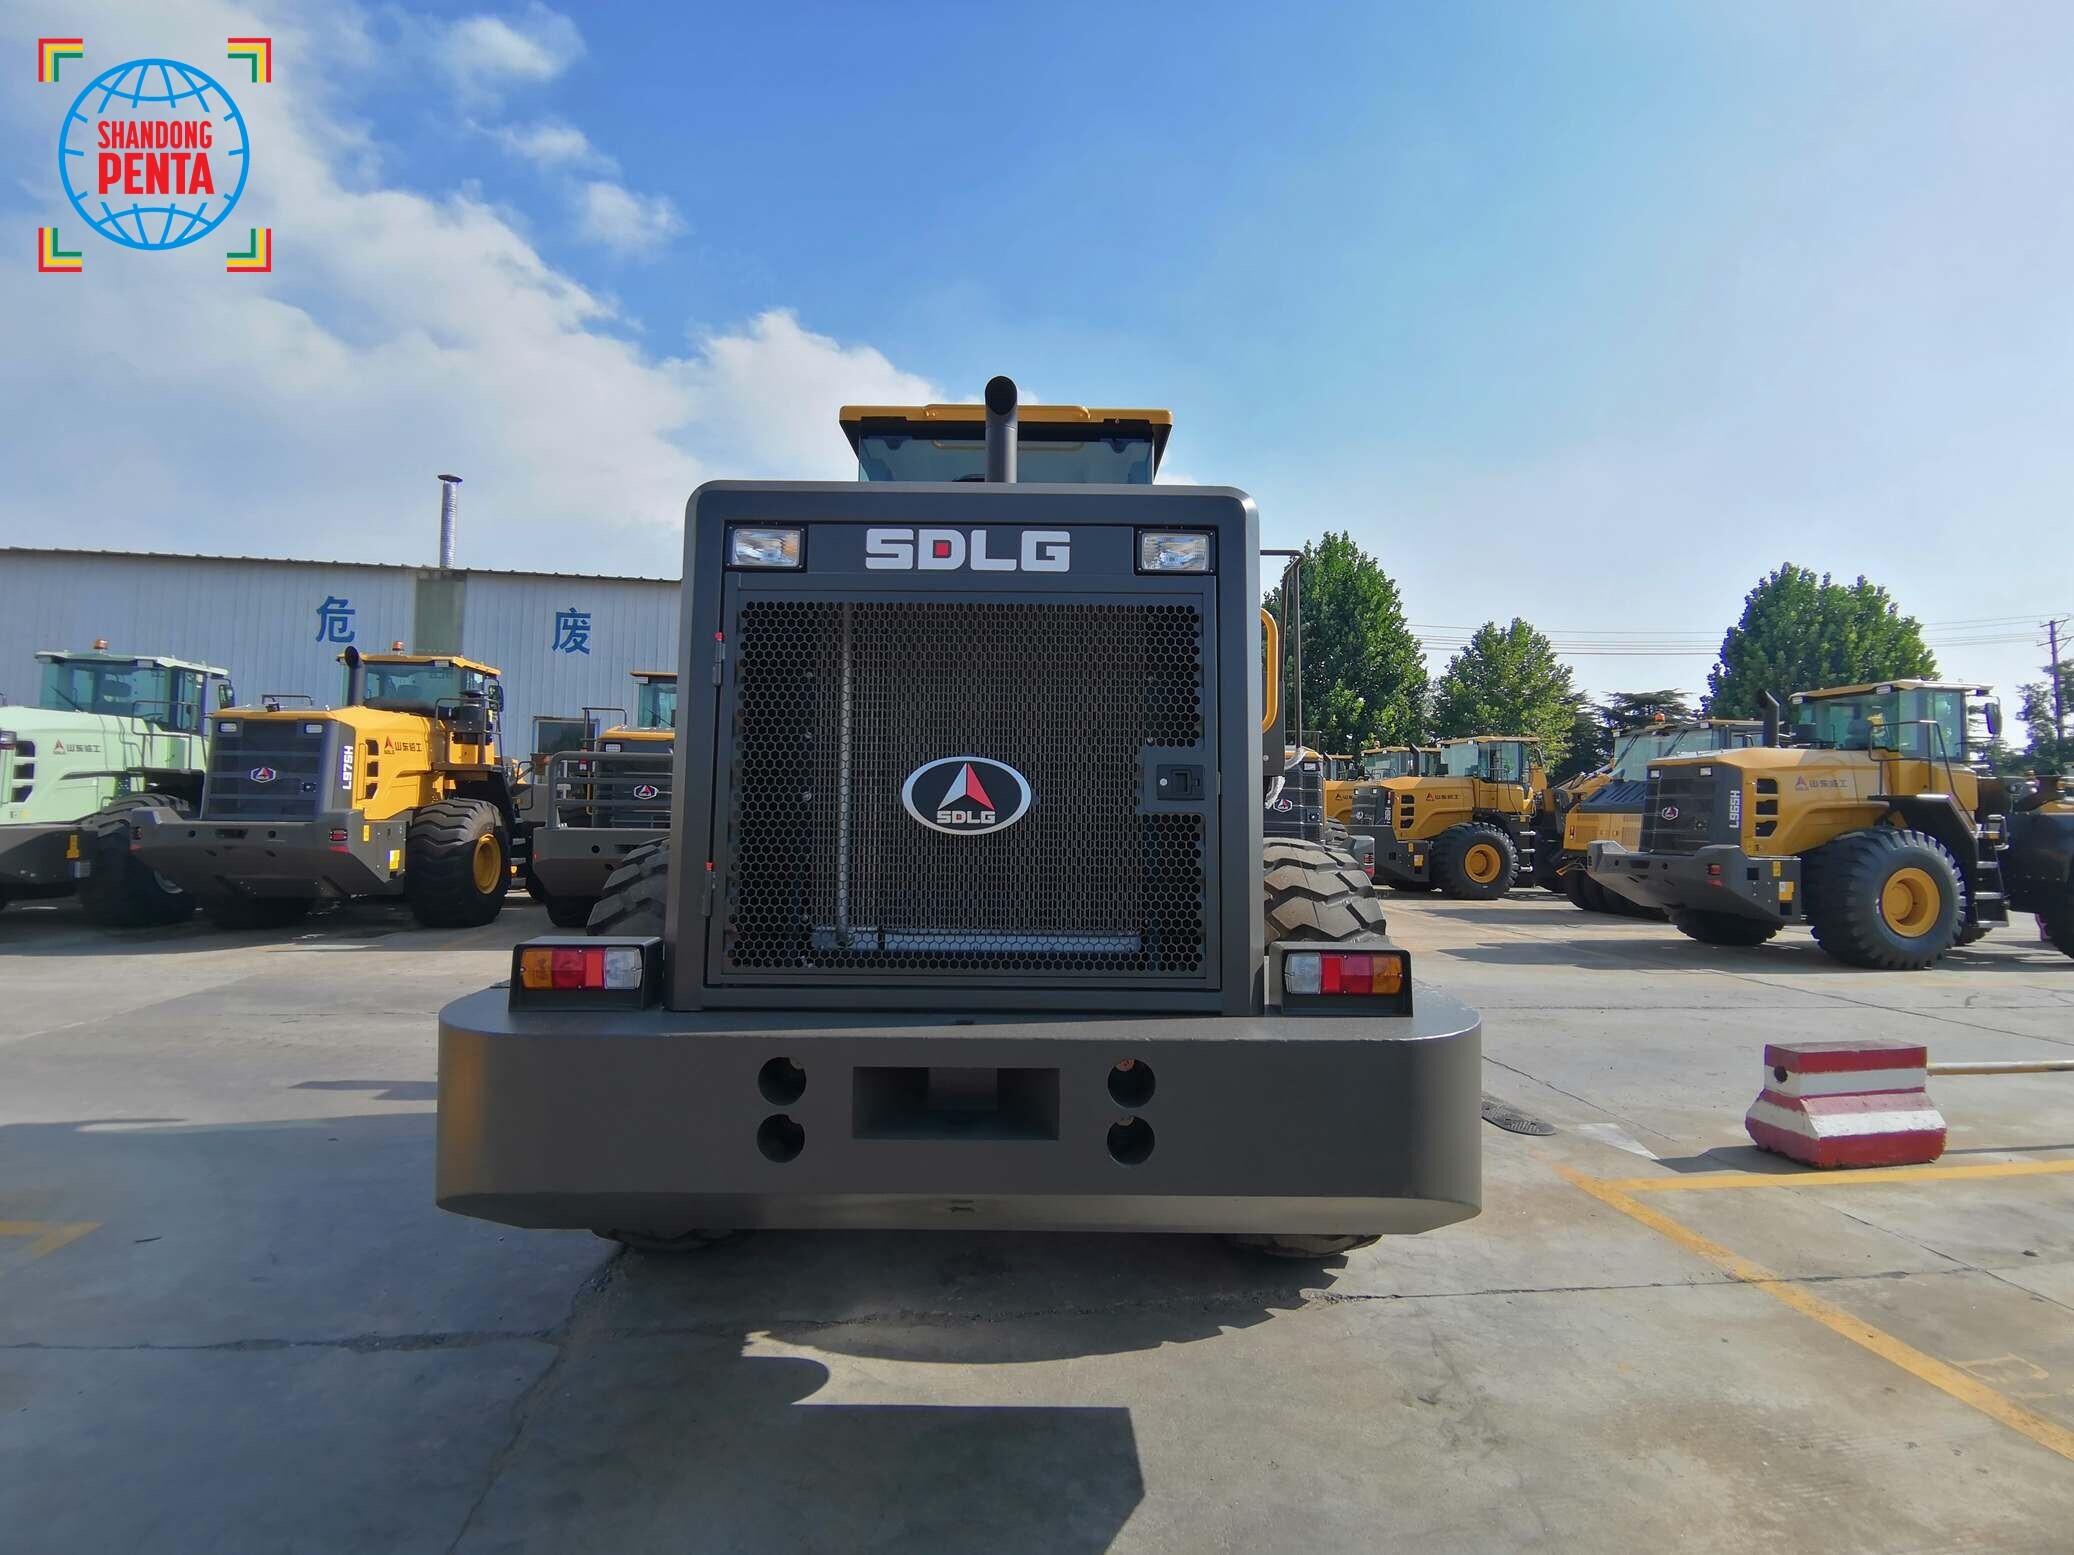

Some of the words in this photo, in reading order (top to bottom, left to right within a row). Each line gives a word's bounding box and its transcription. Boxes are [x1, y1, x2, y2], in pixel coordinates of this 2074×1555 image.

[865, 528, 1071, 573] SDLG
[315, 596, 356, 643] 危
[551, 607, 592, 655] 废
[342, 745, 354, 790] L975H
[937, 810, 996, 824] SDLG
